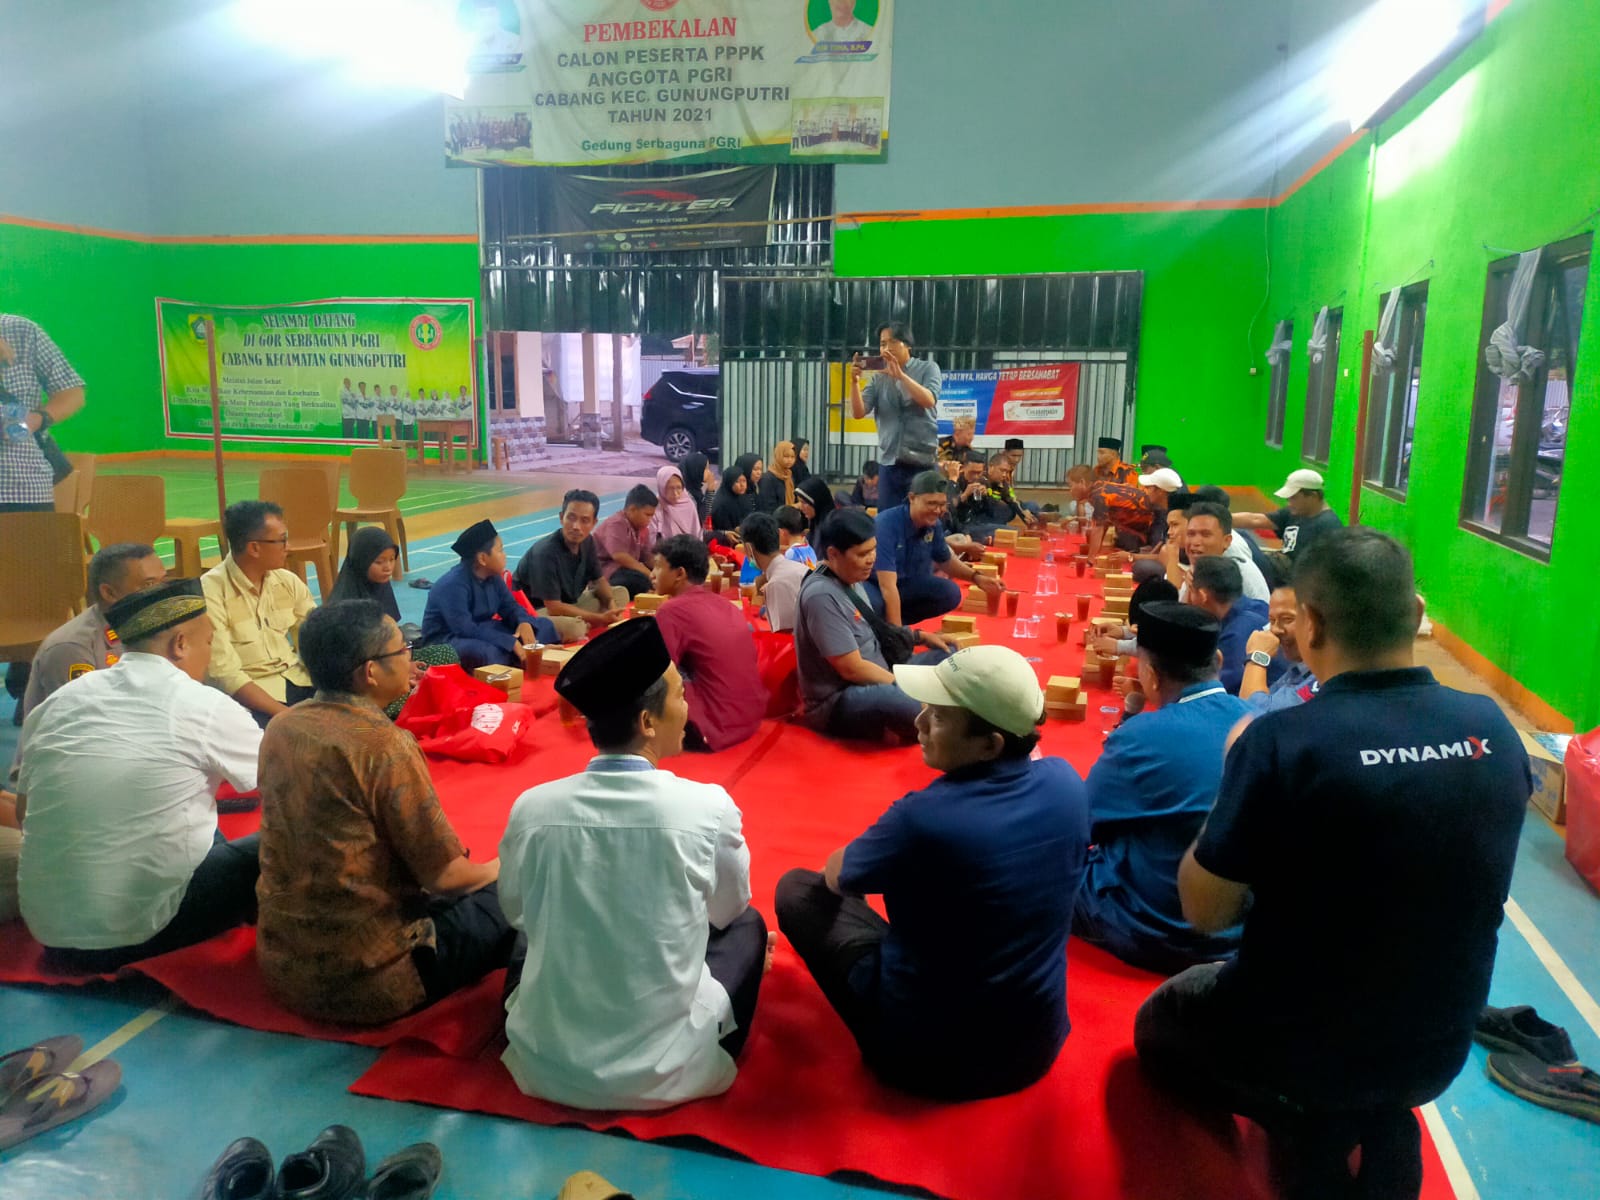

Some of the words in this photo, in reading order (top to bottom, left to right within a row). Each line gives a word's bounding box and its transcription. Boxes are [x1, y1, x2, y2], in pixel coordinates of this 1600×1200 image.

[583, 17, 737, 42] PEMBEKALAN
[557, 51, 619, 67] CALON
[625, 47, 709, 64] PESERTA
[715, 45, 764, 61] PPPK
[588, 69, 680, 87] ANGGOTA
[687, 66, 732, 83] PGRI
[535, 91, 606, 106] CABANG
[611, 89, 650, 104] KEC.
[657, 86, 790, 102] GUNUNGPUTRI
[608, 108, 666, 123] TAHUN
[672, 107, 712, 122] 2021
[581, 139, 632, 152] Gedung
[636, 137, 706, 151] Serbaguna
[709, 136, 741, 149] PGRI
[262, 314, 309, 328] SELAMAT
[313, 313, 356, 328] DATANG
[243, 333, 256, 348] DI
[258, 333, 282, 348] GOR
[285, 333, 347, 348] SERBAGUNA
[351, 333, 380, 348] PGRI
[222, 352, 263, 367] CABANG
[265, 353, 326, 368] KECAMATAN
[329, 353, 407, 368] GUNUNGPUTRI
[1359, 736, 1493, 766] DYNAMIX
